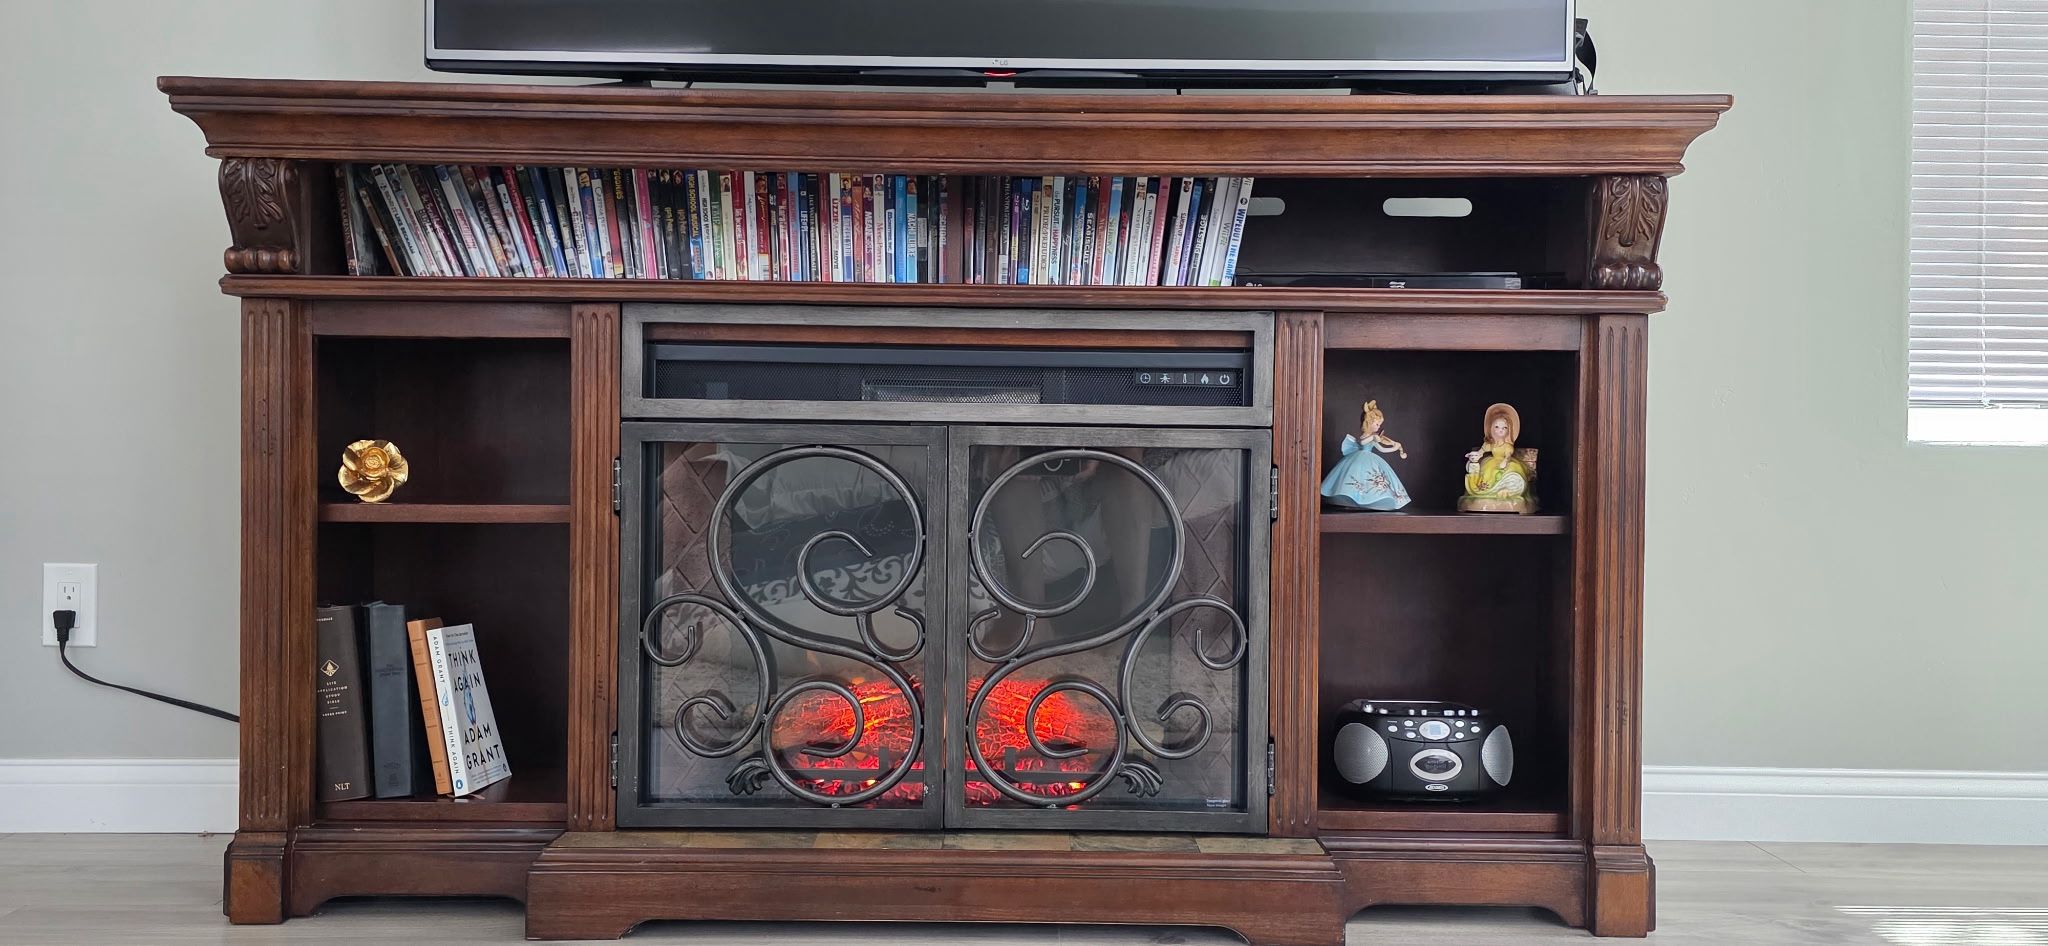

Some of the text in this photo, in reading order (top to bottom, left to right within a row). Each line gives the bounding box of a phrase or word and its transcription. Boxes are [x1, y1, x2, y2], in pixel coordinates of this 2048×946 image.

[613, 171, 624, 199] GOONIES
[689, 190, 697, 214] SCHOOL
[832, 198, 840, 222] LIZZIE
[1053, 198, 1061, 225] PURSUIT
[341, 208, 352, 245] KARENINA
[691, 213, 700, 238] MUSICAL
[800, 210, 808, 223] LIFE
[864, 210, 873, 234] MEAN
[907, 212, 917, 235] NACHO
[1232, 207, 1247, 241] WIPEOUT
[394, 213, 405, 227] LIKE
[400, 225, 416, 255] BECKHAM
[575, 233, 585, 255] PLAN
[939, 214, 947, 248] SCHOOL
[1083, 212, 1094, 265] SEABISCUIT
[1195, 214, 1208, 254] PRESTIGE
[1040, 232, 1049, 272] PREJUDICE
[1050, 229, 1060, 265] HAPPYNESS
[1224, 258, 1236, 280] GAME
[432, 636, 445, 684] ADAM GRANT
[448, 649, 477, 669] THINK
[453, 672, 482, 693] AGAIN
[464, 722, 492, 745] ADAM
[448, 725, 461, 774] THINK AGAIN
[466, 743, 501, 770] GRANT
[334, 782, 351, 791] NLT
